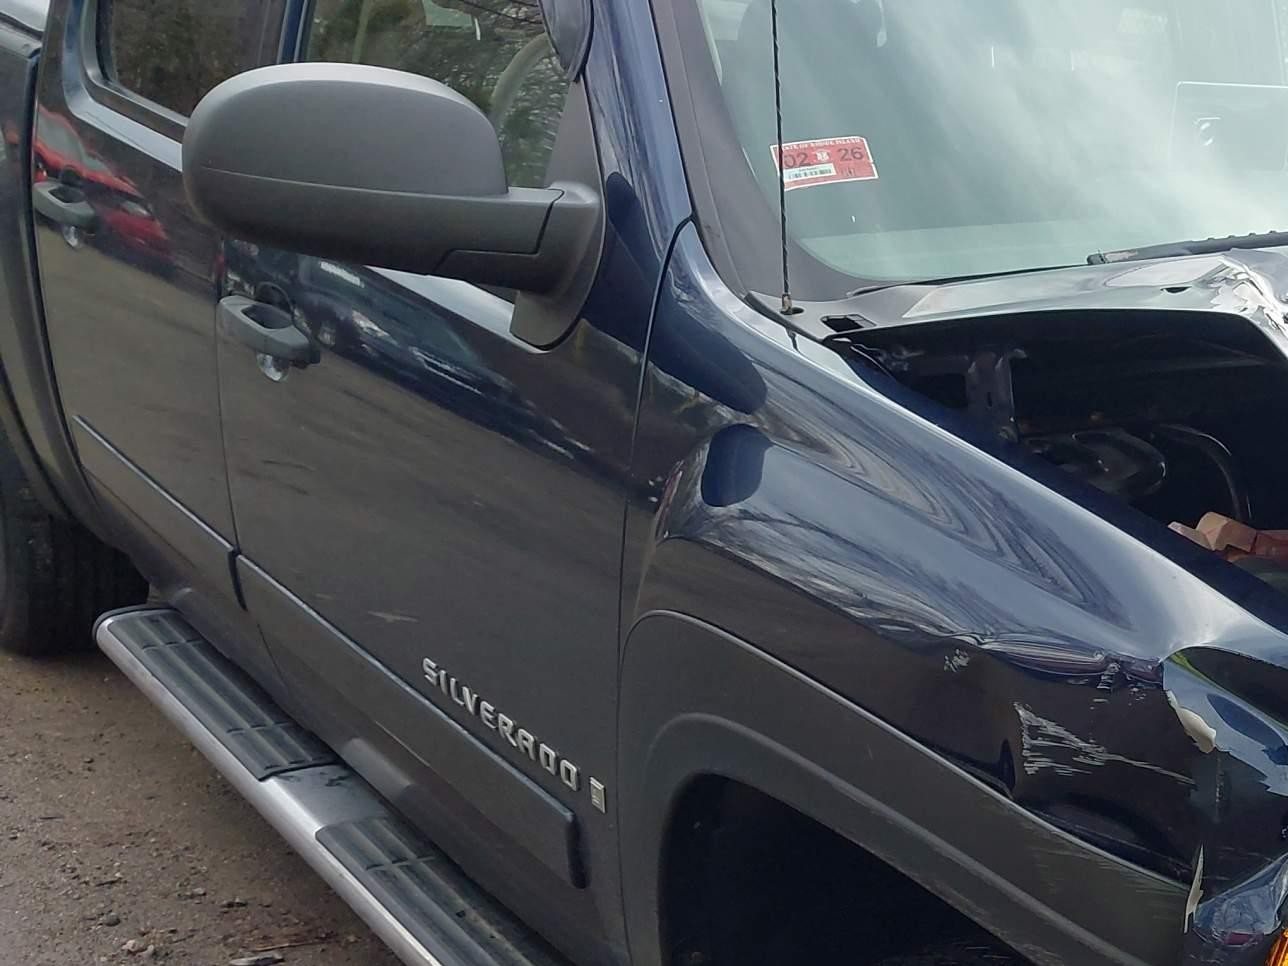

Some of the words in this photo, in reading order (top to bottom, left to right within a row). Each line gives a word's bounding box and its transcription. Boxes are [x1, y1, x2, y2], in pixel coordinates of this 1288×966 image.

[784, 152, 811, 169] 02
[837, 147, 865, 161] 26
[422, 657, 579, 792] SILVERADO
